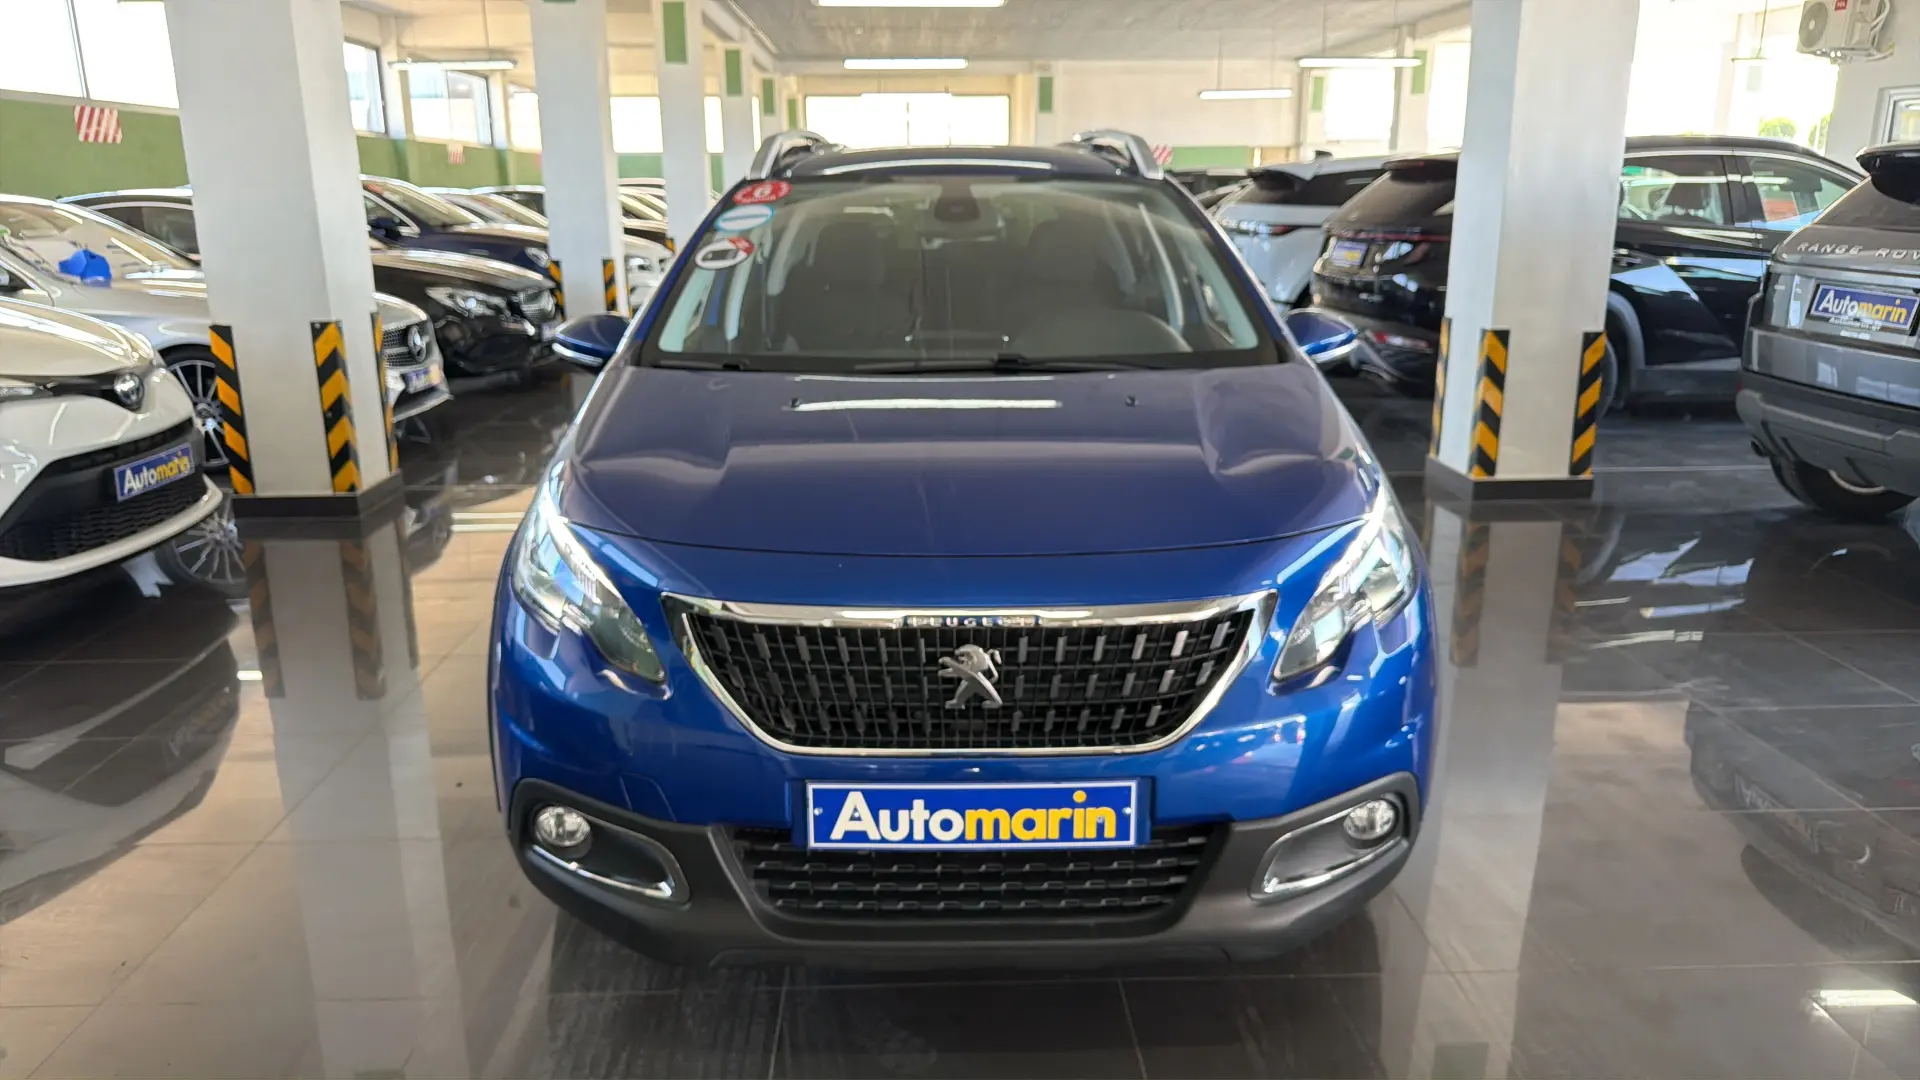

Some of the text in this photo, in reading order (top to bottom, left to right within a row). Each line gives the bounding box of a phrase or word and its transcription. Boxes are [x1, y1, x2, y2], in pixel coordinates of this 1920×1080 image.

[1797, 242, 1863, 255] RANGE
[1818, 289, 1907, 324] Automarin
[829, 791, 1116, 841] Automarin
